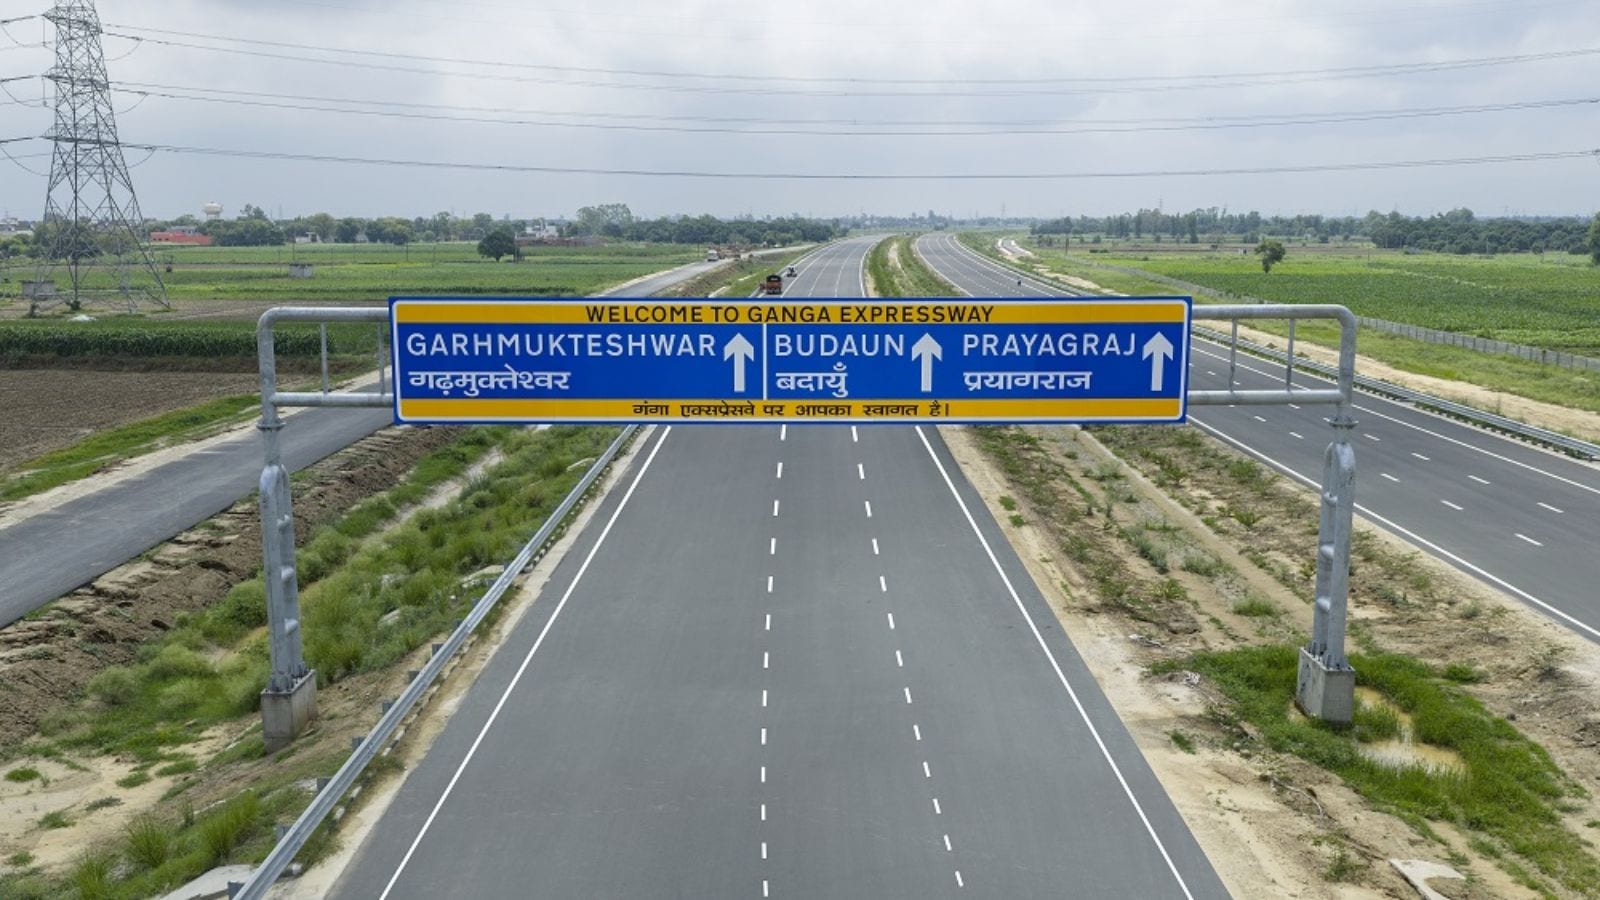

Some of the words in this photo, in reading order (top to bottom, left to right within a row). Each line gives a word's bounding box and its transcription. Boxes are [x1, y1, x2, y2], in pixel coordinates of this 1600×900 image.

[586, 305, 703, 323] WELCOME
[710, 305, 739, 323] TO
[748, 305, 831, 323] GANGA
[840, 304, 994, 323] EXPRESSWAY
[406, 333, 716, 357] GARHMUKTESHWAR
[774, 333, 905, 356] BUDAUN
[962, 333, 1136, 357] PRAYAGRAJ
[408, 364, 571, 397] गढ़मुक्तेश्वर
[963, 370, 1093, 391] प्रयागराज
[632, 401, 670, 416] गंगा
[680, 401, 756, 418] एक्सप्रेसवे
[763, 404, 785, 417] पर
[795, 404, 852, 417] आपका
[862, 404, 919, 417] स्वागत
